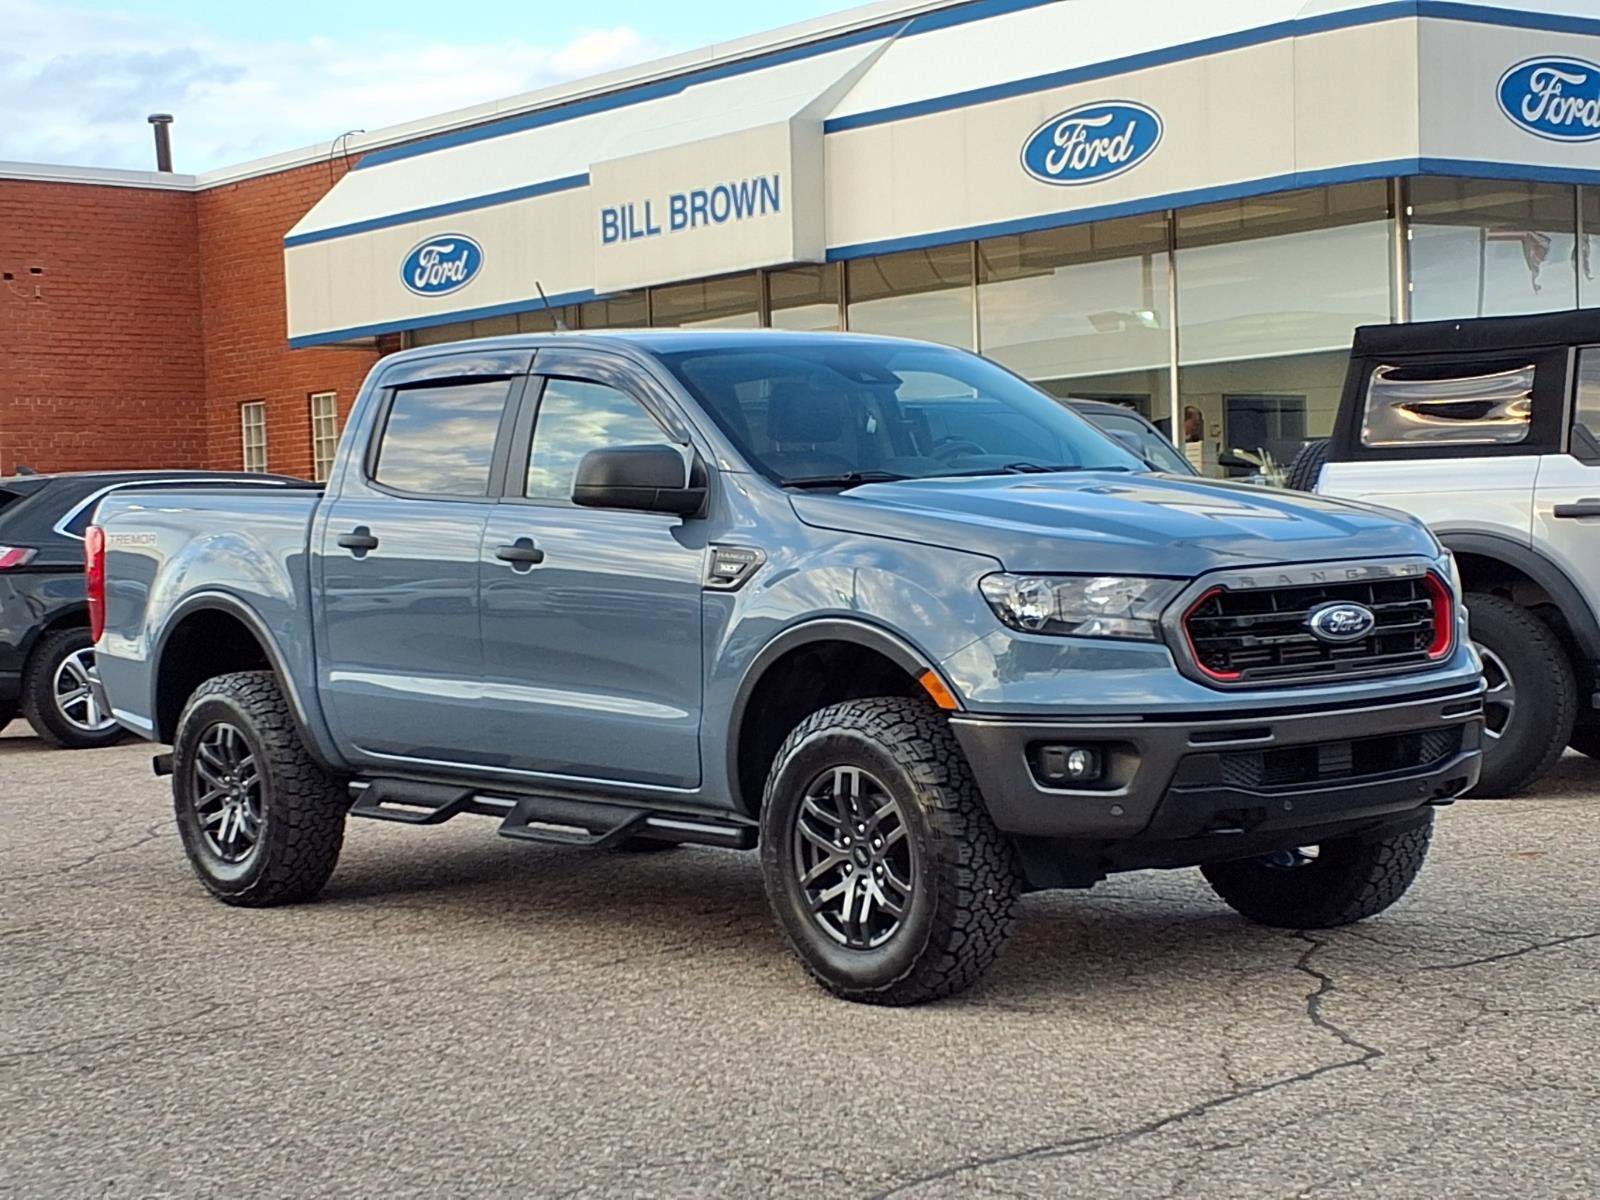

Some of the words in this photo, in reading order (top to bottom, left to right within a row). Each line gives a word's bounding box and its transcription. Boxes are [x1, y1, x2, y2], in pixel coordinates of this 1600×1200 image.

[1045, 113, 1137, 175] Ford
[602, 200, 661, 244] BILL
[670, 174, 781, 232] BROWN
[414, 243, 469, 288] Ford
[108, 533, 157, 545] TREMOR
[1329, 610, 1364, 633] Ford
